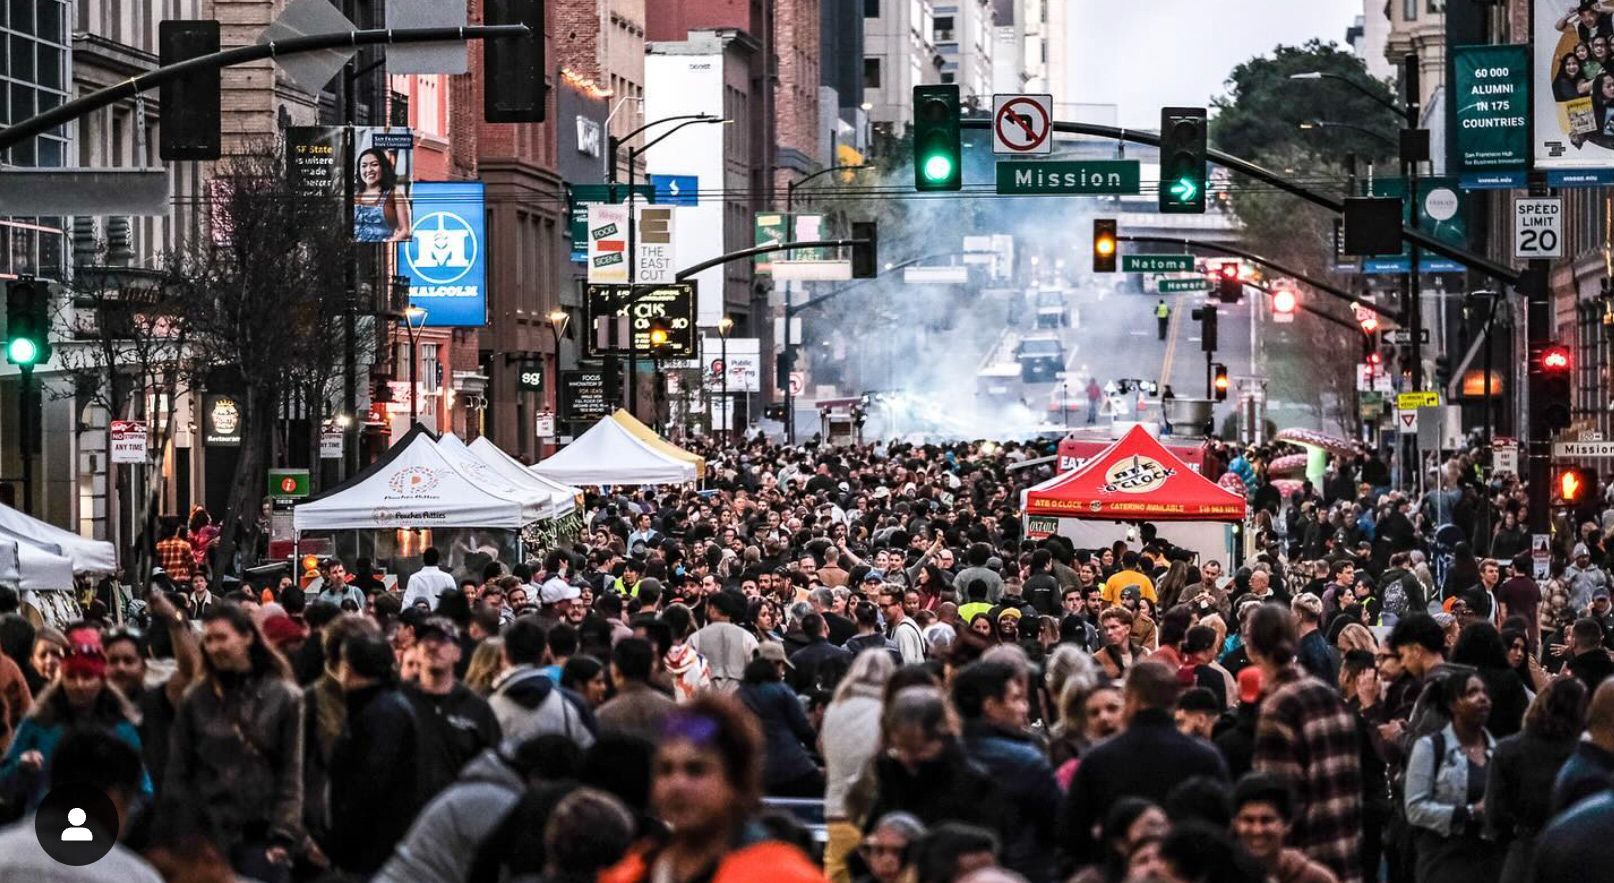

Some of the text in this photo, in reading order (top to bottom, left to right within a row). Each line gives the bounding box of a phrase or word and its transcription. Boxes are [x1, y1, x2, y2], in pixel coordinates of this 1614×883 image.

[1475, 68, 1509, 79] 60 000
[1471, 84, 1514, 95] ALUMNI
[1477, 101, 1509, 112] IN 175
[1463, 117, 1525, 129] COUNTRIES
[309, 145, 333, 154] State
[1015, 168, 1121, 187] Mission
[1519, 205, 1559, 215] SPEED
[1522, 217, 1554, 227] LIMIT
[594, 226, 616, 239] FOOD
[1520, 229, 1558, 252] 20
[641, 247, 664, 258] THE
[596, 254, 622, 266] SCENE
[641, 257, 671, 269] EAST
[1131, 259, 1186, 269] Natoma
[640, 269, 665, 281] CUT
[1168, 280, 1207, 289] Howard
[408, 285, 479, 298] MALCOLM
[521, 372, 541, 386] sg
[115, 443, 143, 452] ANY TIME
[1035, 499, 1050, 507] ATE
[1110, 503, 1145, 511] CATERING
[1145, 504, 1184, 513] AVAILABLE
[1030, 521, 1058, 533] OXTAILS
